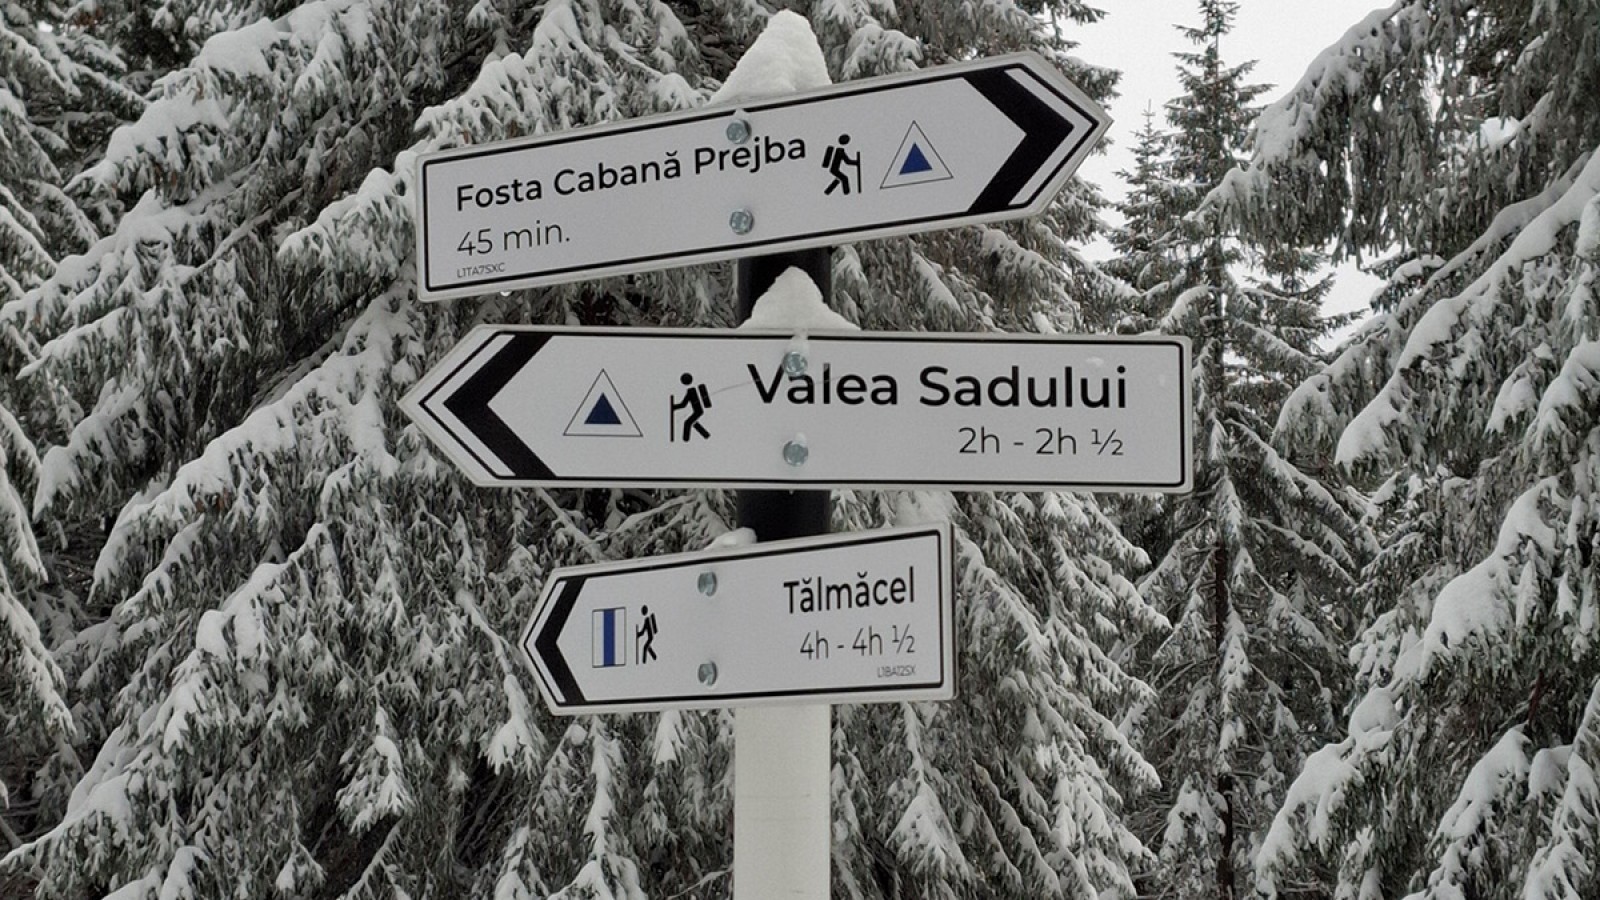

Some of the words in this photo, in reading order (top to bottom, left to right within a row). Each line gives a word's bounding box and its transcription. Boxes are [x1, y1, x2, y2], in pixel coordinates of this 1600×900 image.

[457, 179, 542, 211] Fosta
[554, 150, 681, 195] Cabană
[694, 136, 806, 175] Prejba
[457, 229, 492, 256] 45
[504, 222, 570, 251] min.
[747, 362, 898, 405] Valea
[920, 365, 1126, 408] Sadului
[958, 426, 1000, 454] 2h
[1036, 427, 1076, 455] 2h
[783, 567, 914, 614] Tălmăcel
[800, 630, 829, 660] 4h
[852, 625, 882, 656] 4h
